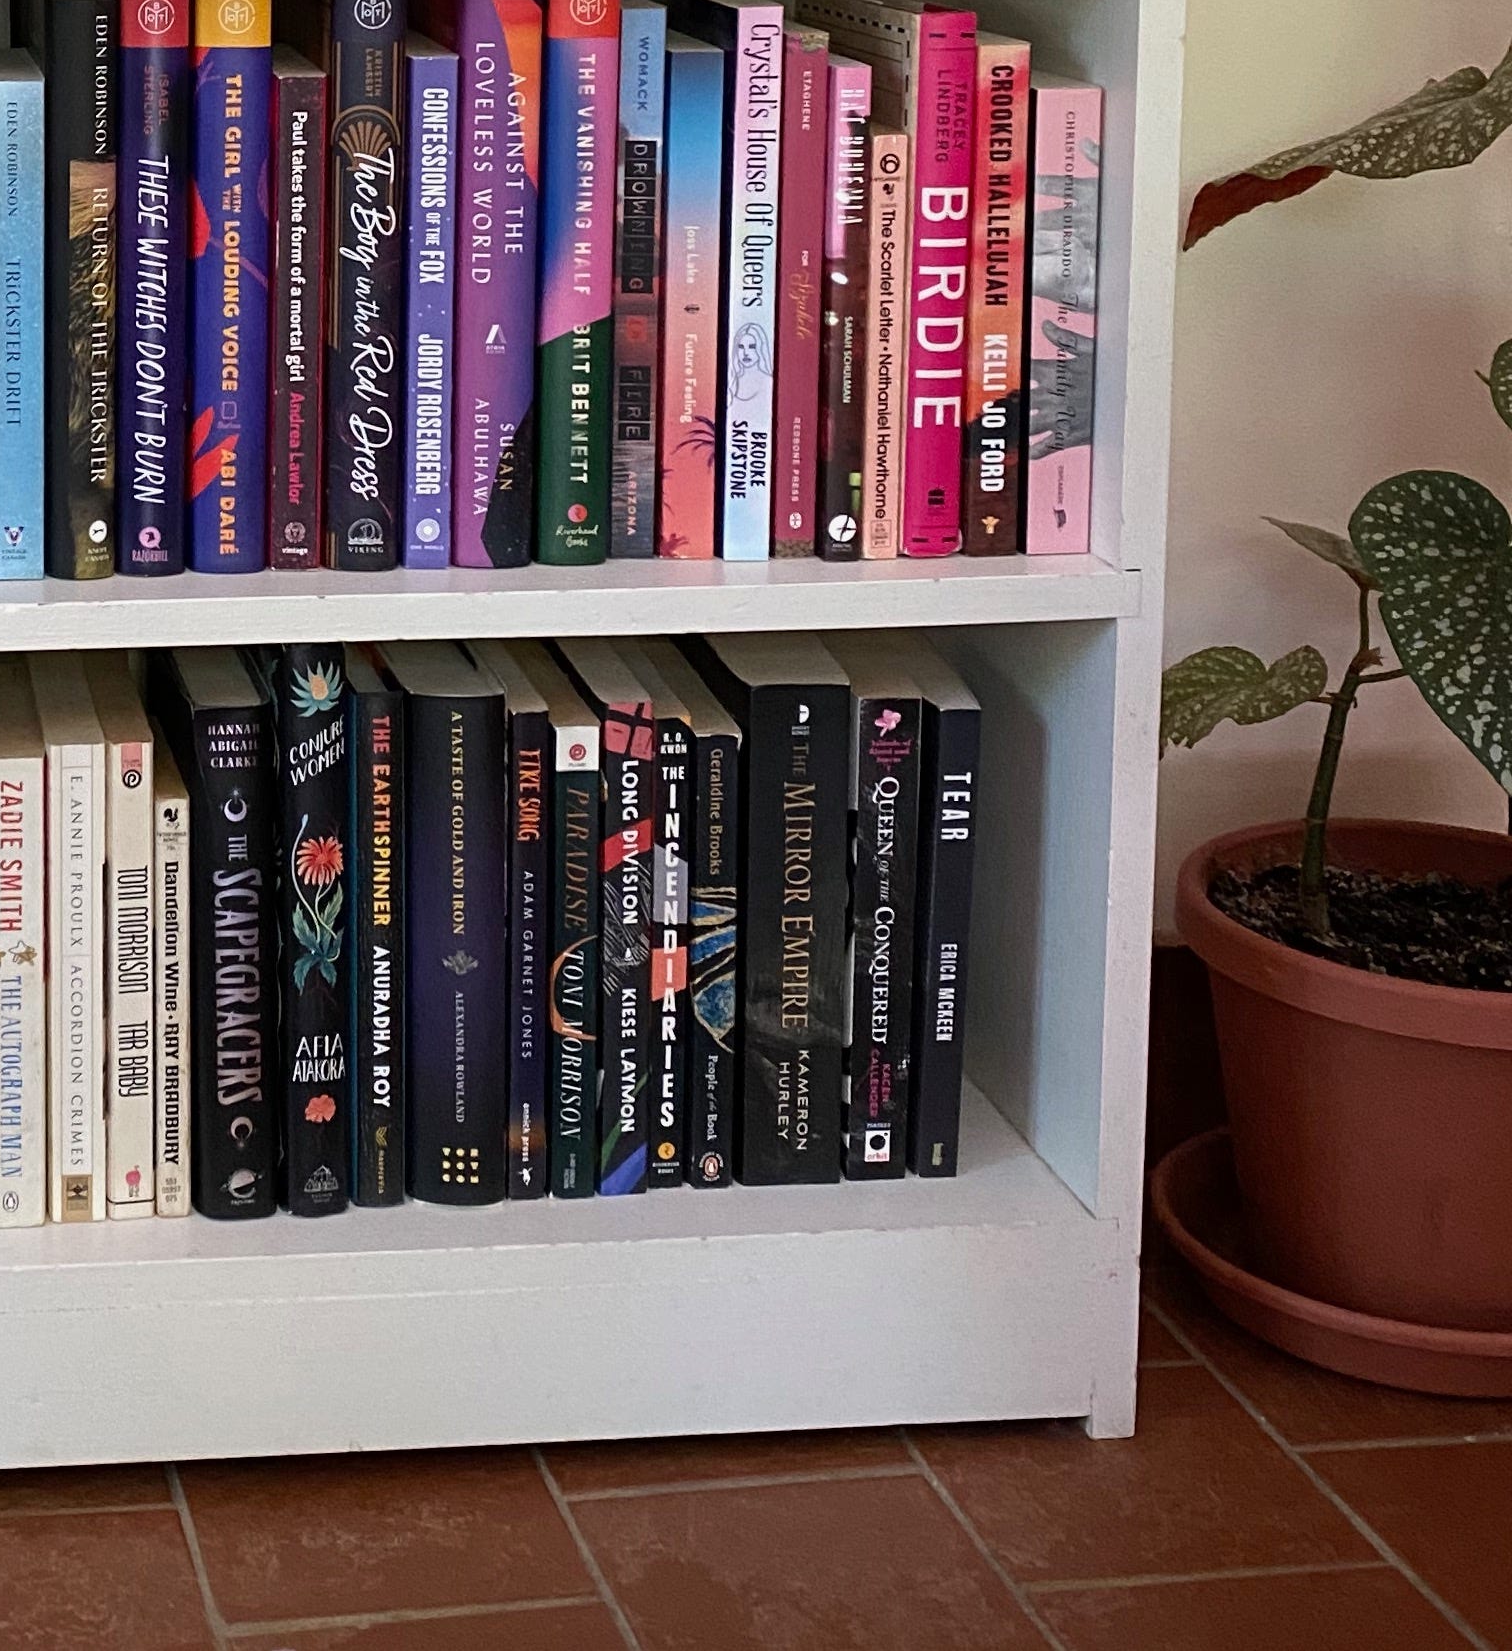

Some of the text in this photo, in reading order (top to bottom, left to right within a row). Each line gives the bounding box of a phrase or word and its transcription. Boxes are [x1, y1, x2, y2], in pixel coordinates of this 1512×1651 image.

[420, 88, 448, 284] CONFESSIONS OF THE FOX
[134, 156, 168, 504] THESE WITCHES DON'T BURN
[913, 187, 969, 428] BIRDIE
[415, 334, 443, 495] JORDY ROSENBERG
[730, 420, 748, 499] SKIPSTONE
[749, 432, 767, 488] BROOKE
[980, 334, 1008, 492] KELLI JO FORD
[372, 716, 391, 926] THE EARTHSPINNER
[662, 766, 685, 781] THE
[941, 771, 971, 841] TEAR
[0, 782, 24, 932] ZADIE SMITH
[373, 946, 390, 1108] ANURADHA ROY
[661, 784, 679, 1128] INCENDIARIES
[936, 942, 958, 1043] ERICA MCKEEN
[1, 975, 23, 1178] THE AUTOGRAPH MAN
[620, 988, 637, 1133] KIESE LAYMON
[777, 1063, 791, 1139] HURLEY
[796, 1050, 808, 1151] KAMERON
